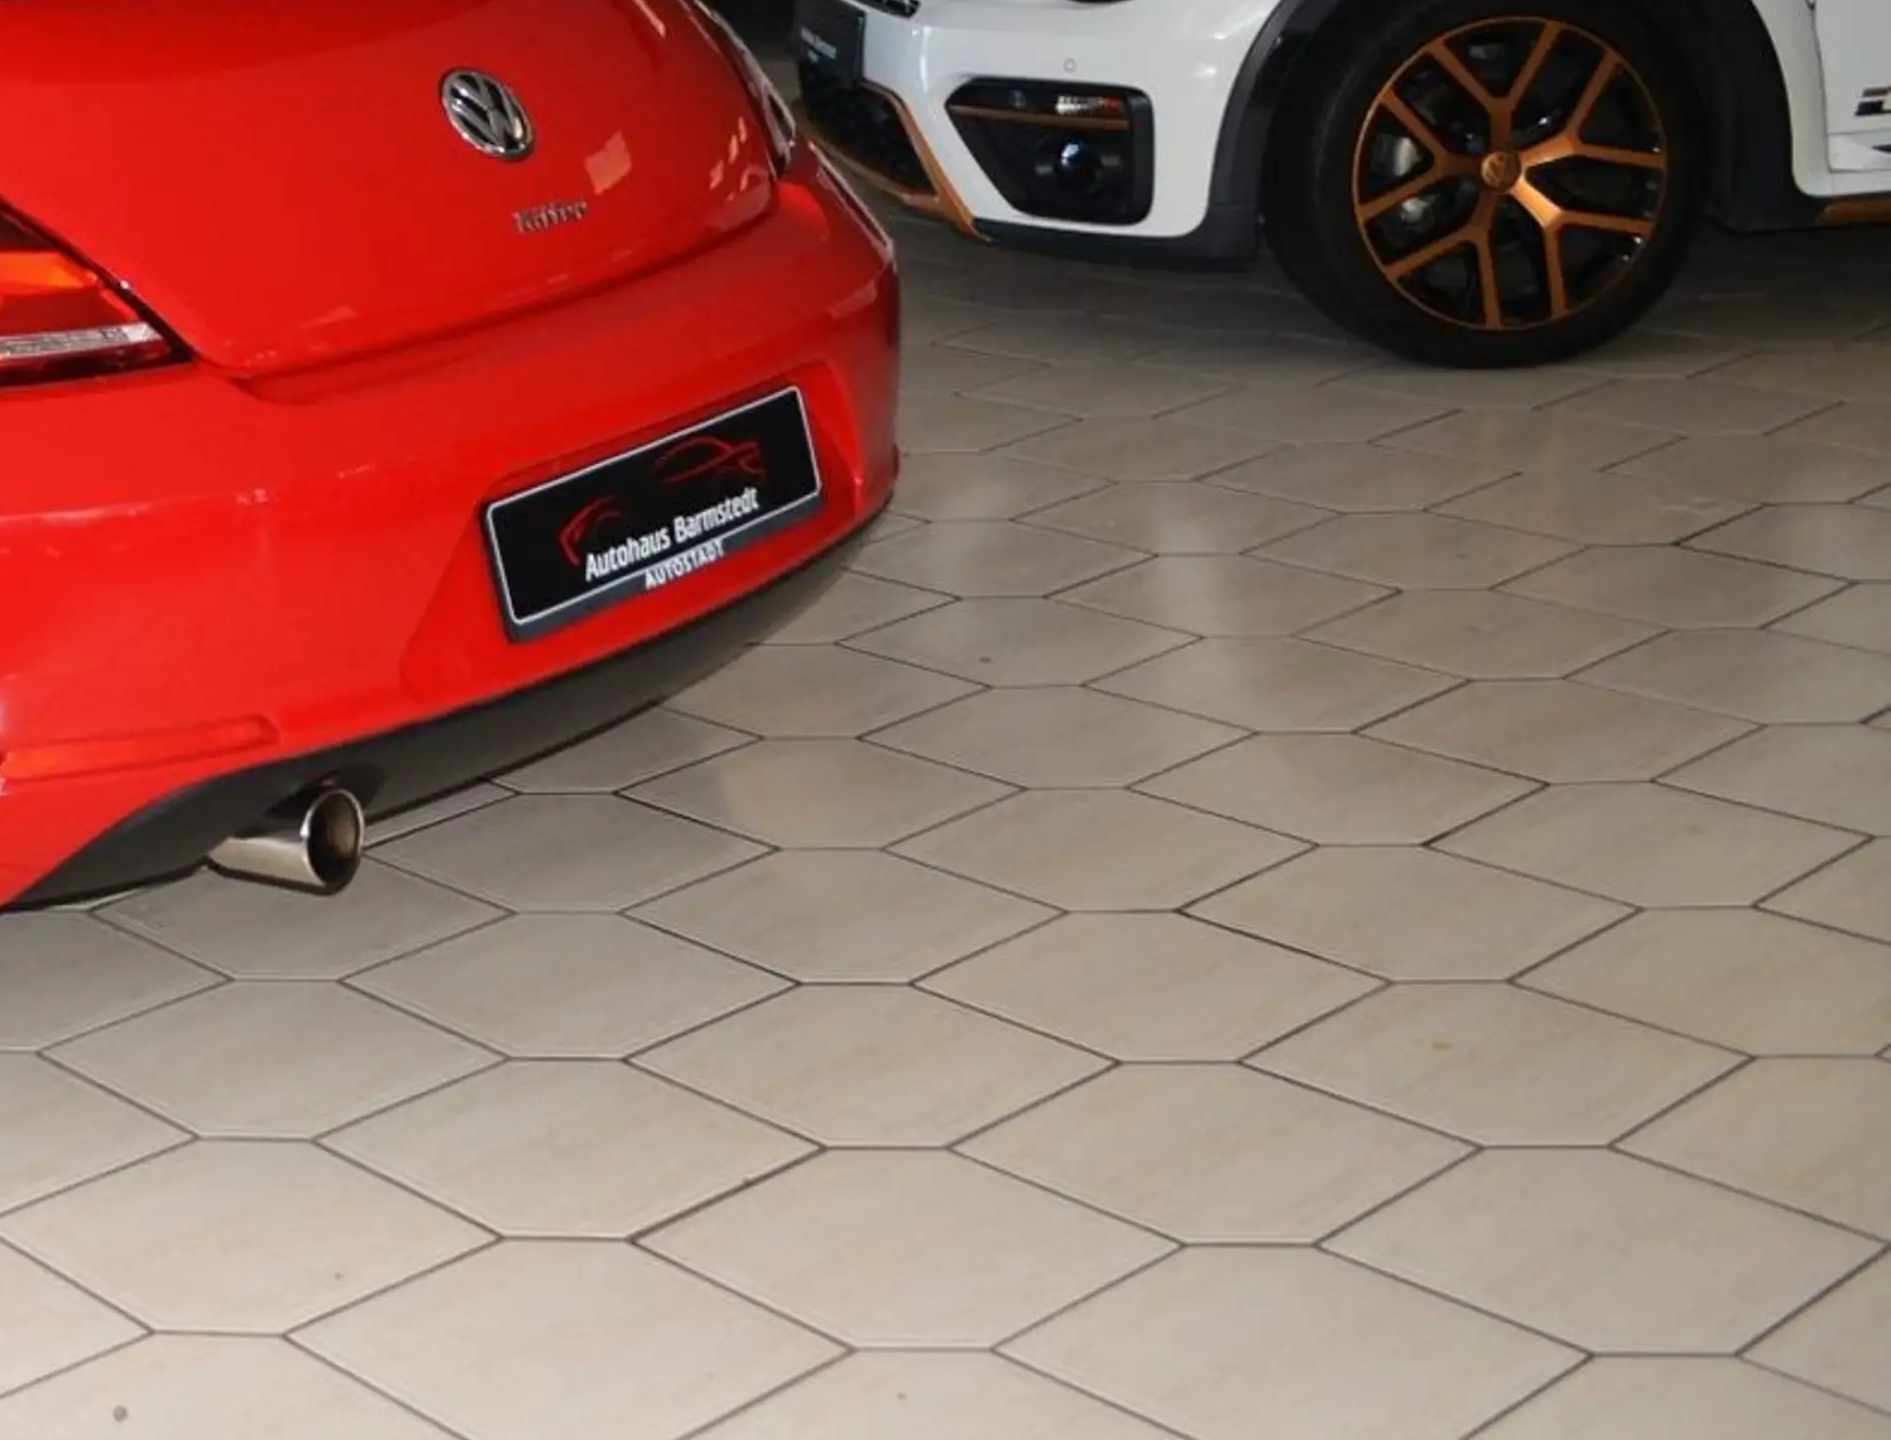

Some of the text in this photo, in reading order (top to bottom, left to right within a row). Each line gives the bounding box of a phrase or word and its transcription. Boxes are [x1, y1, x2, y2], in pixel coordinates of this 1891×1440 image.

[585, 486, 760, 582] Autohaus Barmstedt
[644, 537, 726, 590] AUTOSTADT
